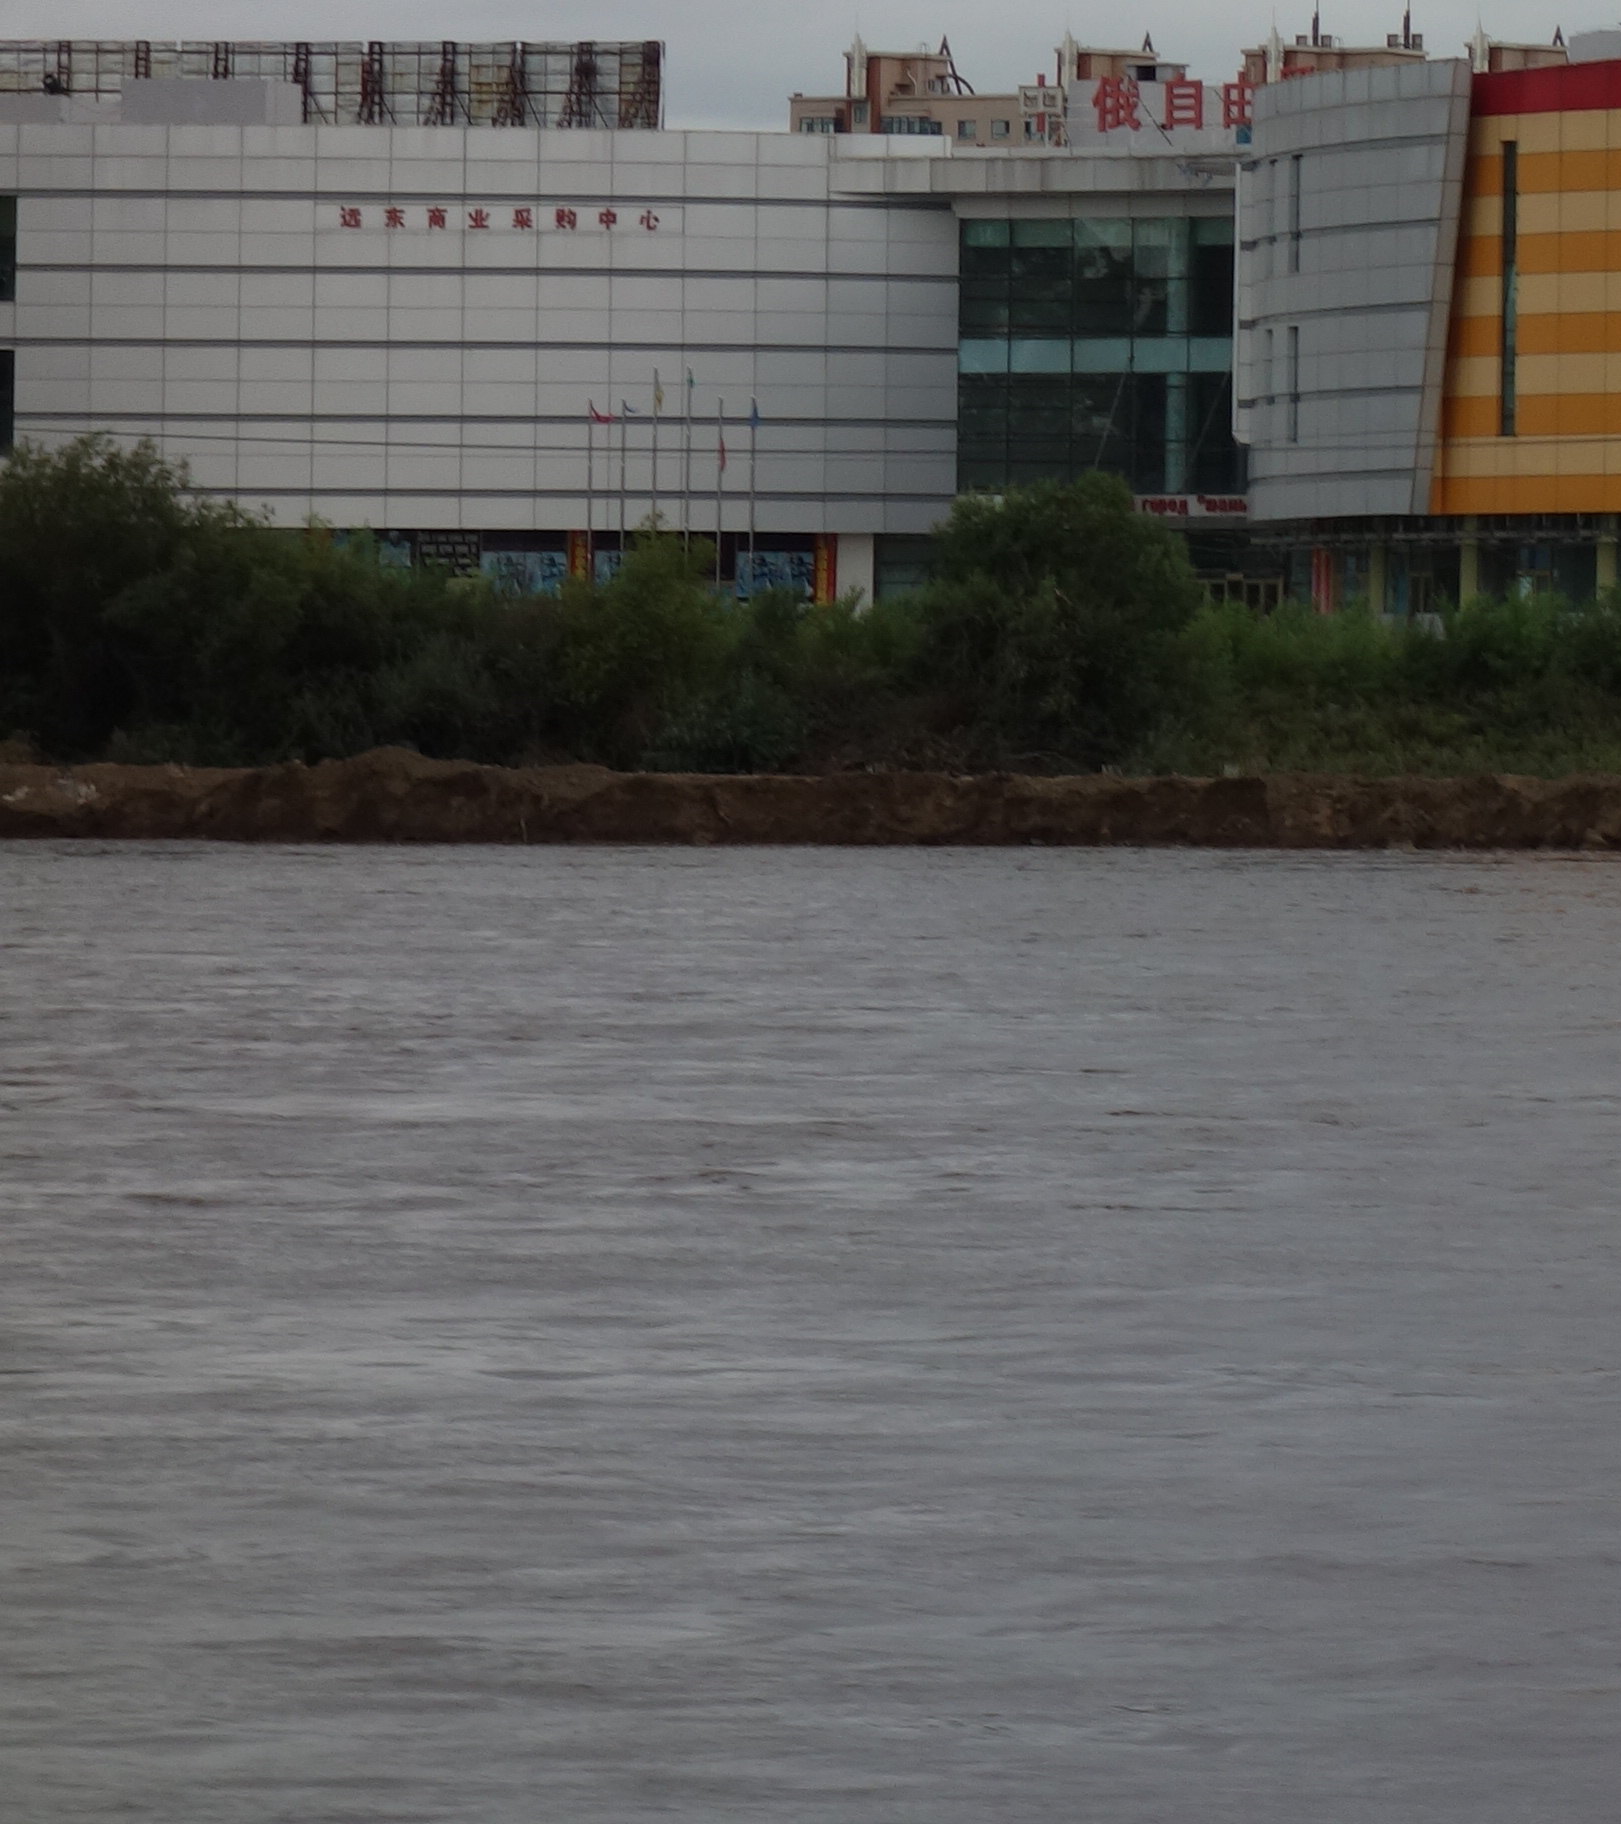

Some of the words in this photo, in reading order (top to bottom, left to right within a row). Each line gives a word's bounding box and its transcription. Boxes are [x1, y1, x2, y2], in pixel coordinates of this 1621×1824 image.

[340, 205, 660, 231] 远东商业采购中心
